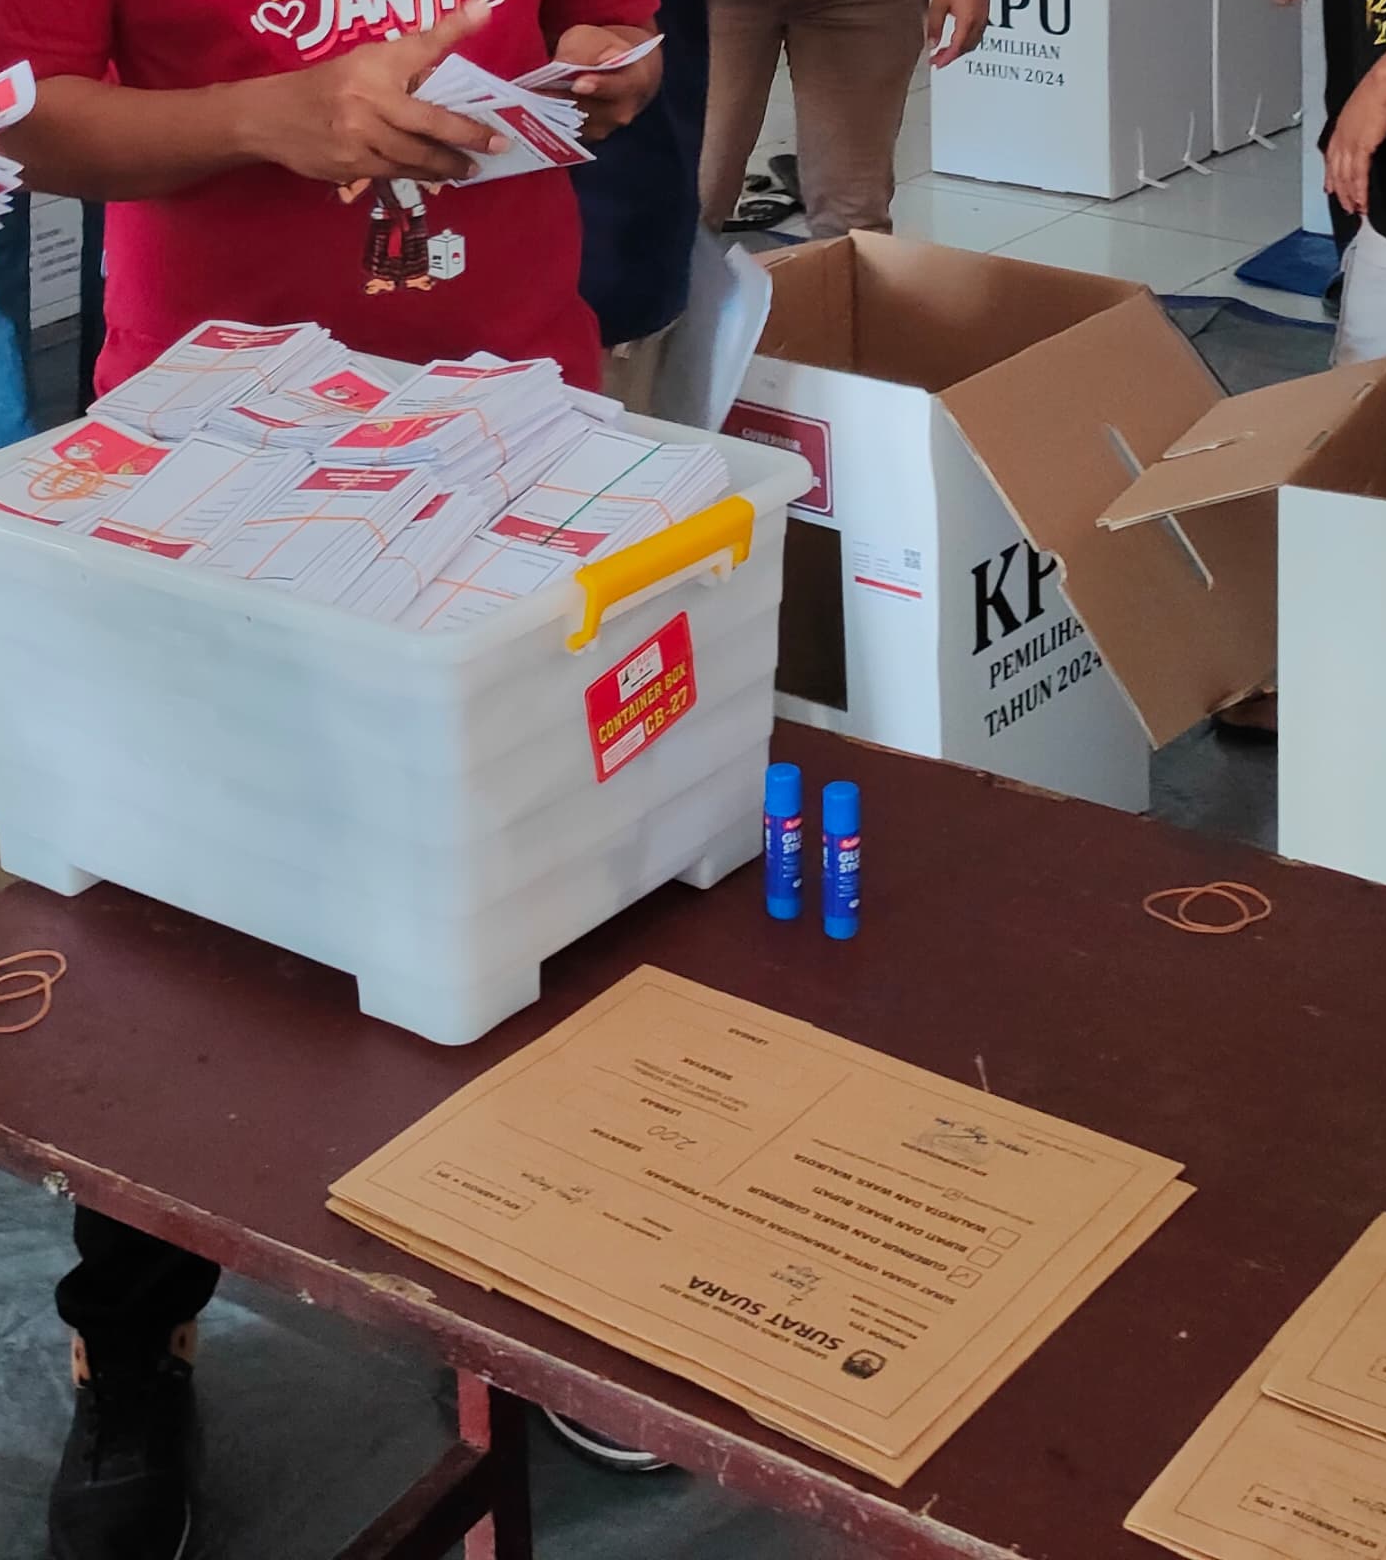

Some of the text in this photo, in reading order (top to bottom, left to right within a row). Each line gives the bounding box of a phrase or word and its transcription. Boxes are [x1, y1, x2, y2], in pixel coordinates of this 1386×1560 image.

[965, 60, 1066, 87] TAHUN 2024
[598, 681, 663, 745] CONTAINER
[664, 661, 687, 690] BOX
[645, 685, 689, 737] CB-27
[984, 679, 1054, 738] TAHUN
[640, 1122, 700, 1153] 200
[790, 1150, 989, 1235] WALIKOTA DAN WAKIL WALIKOTA
[809, 1184, 970, 1254] BUPATI DAN WAKIL BUPATI
[744, 1183, 950, 1274] GUBERNUR DAN WAKIL GUBERNUR
[681, 1273, 847, 1353] SURAT SUARA
